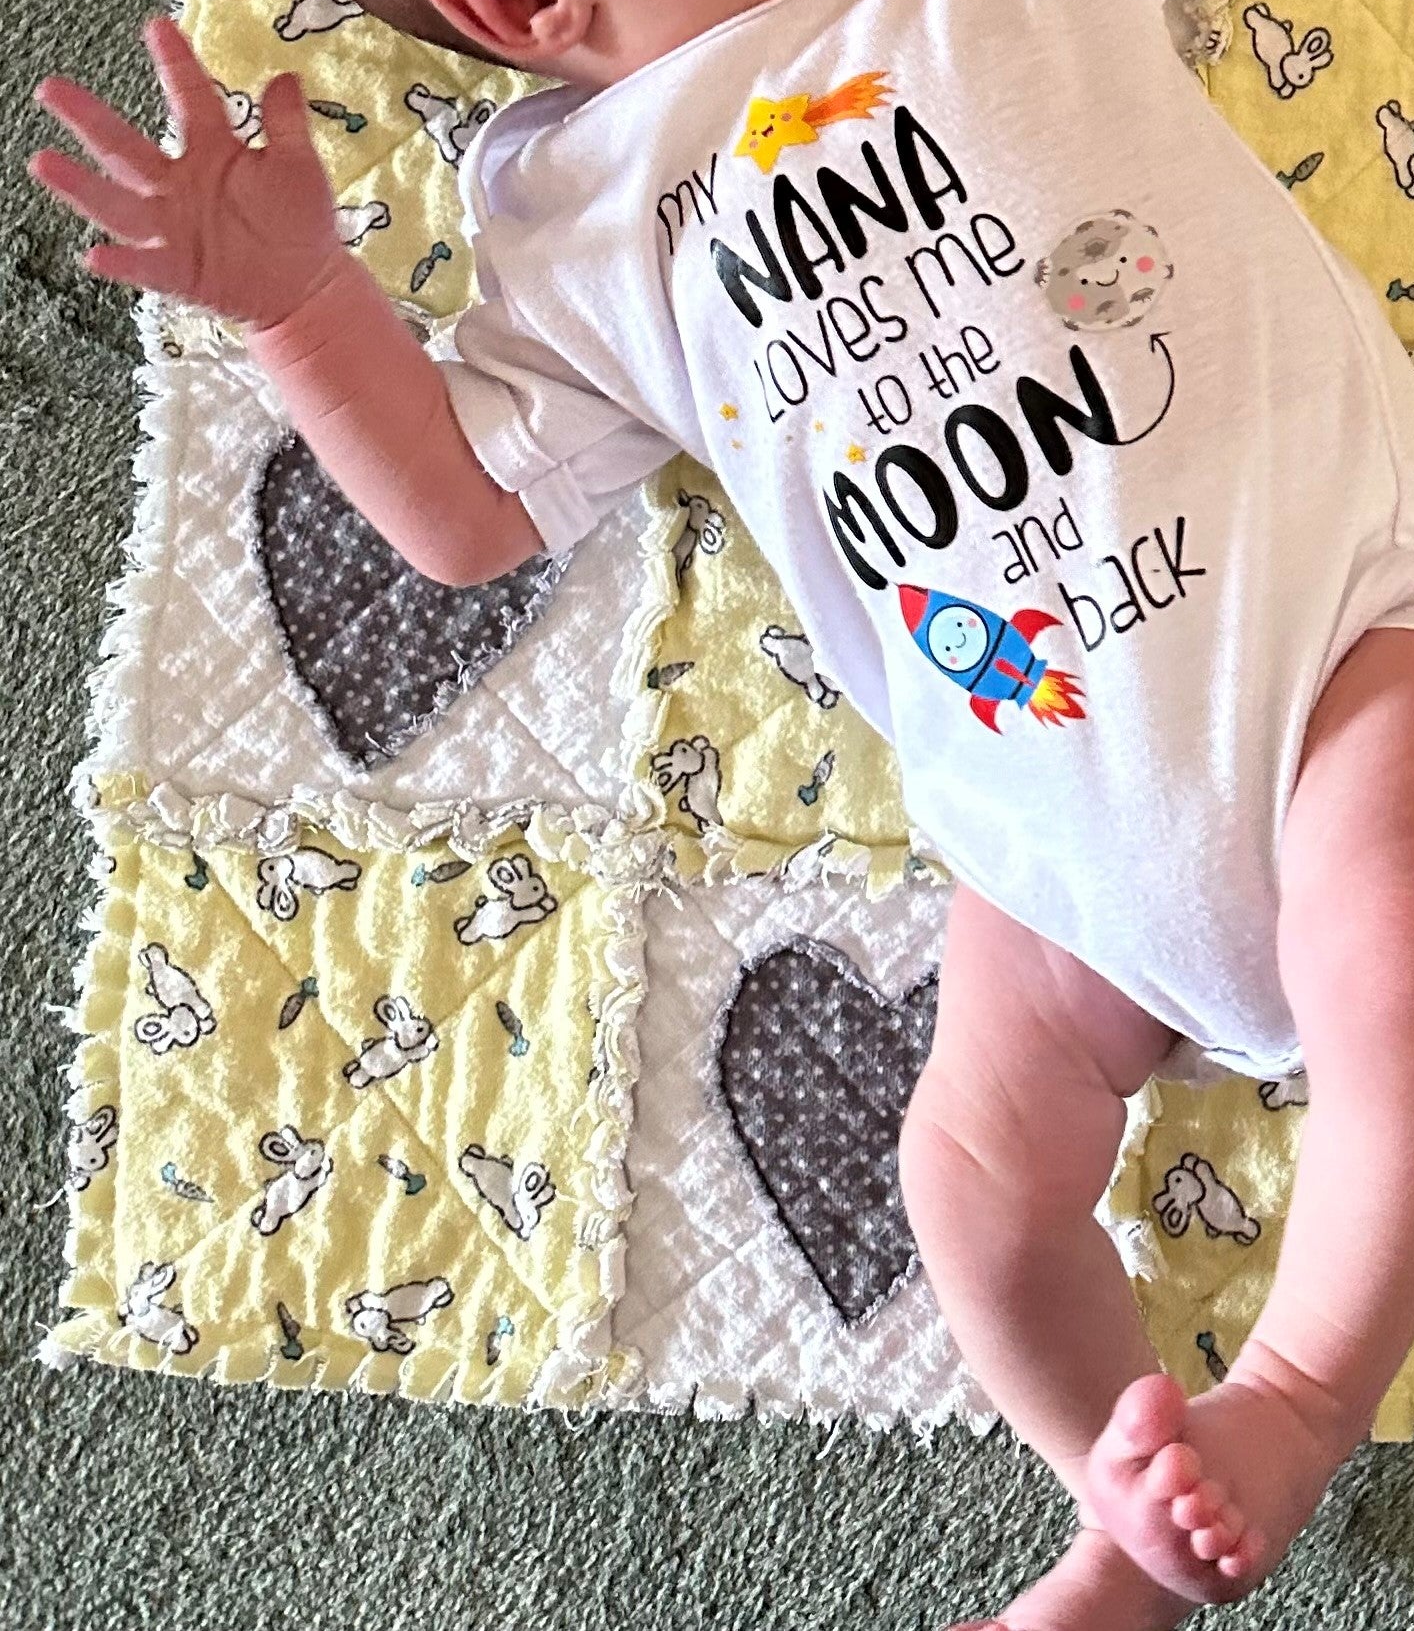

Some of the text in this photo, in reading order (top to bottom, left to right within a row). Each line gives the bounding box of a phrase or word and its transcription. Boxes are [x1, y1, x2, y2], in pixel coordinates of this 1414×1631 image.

[709, 105, 968, 329] NANA
[904, 213, 1025, 319] me
[857, 325, 1001, 435] to the
[823, 344, 1124, 591] MOON
[991, 496, 1084, 585] and
